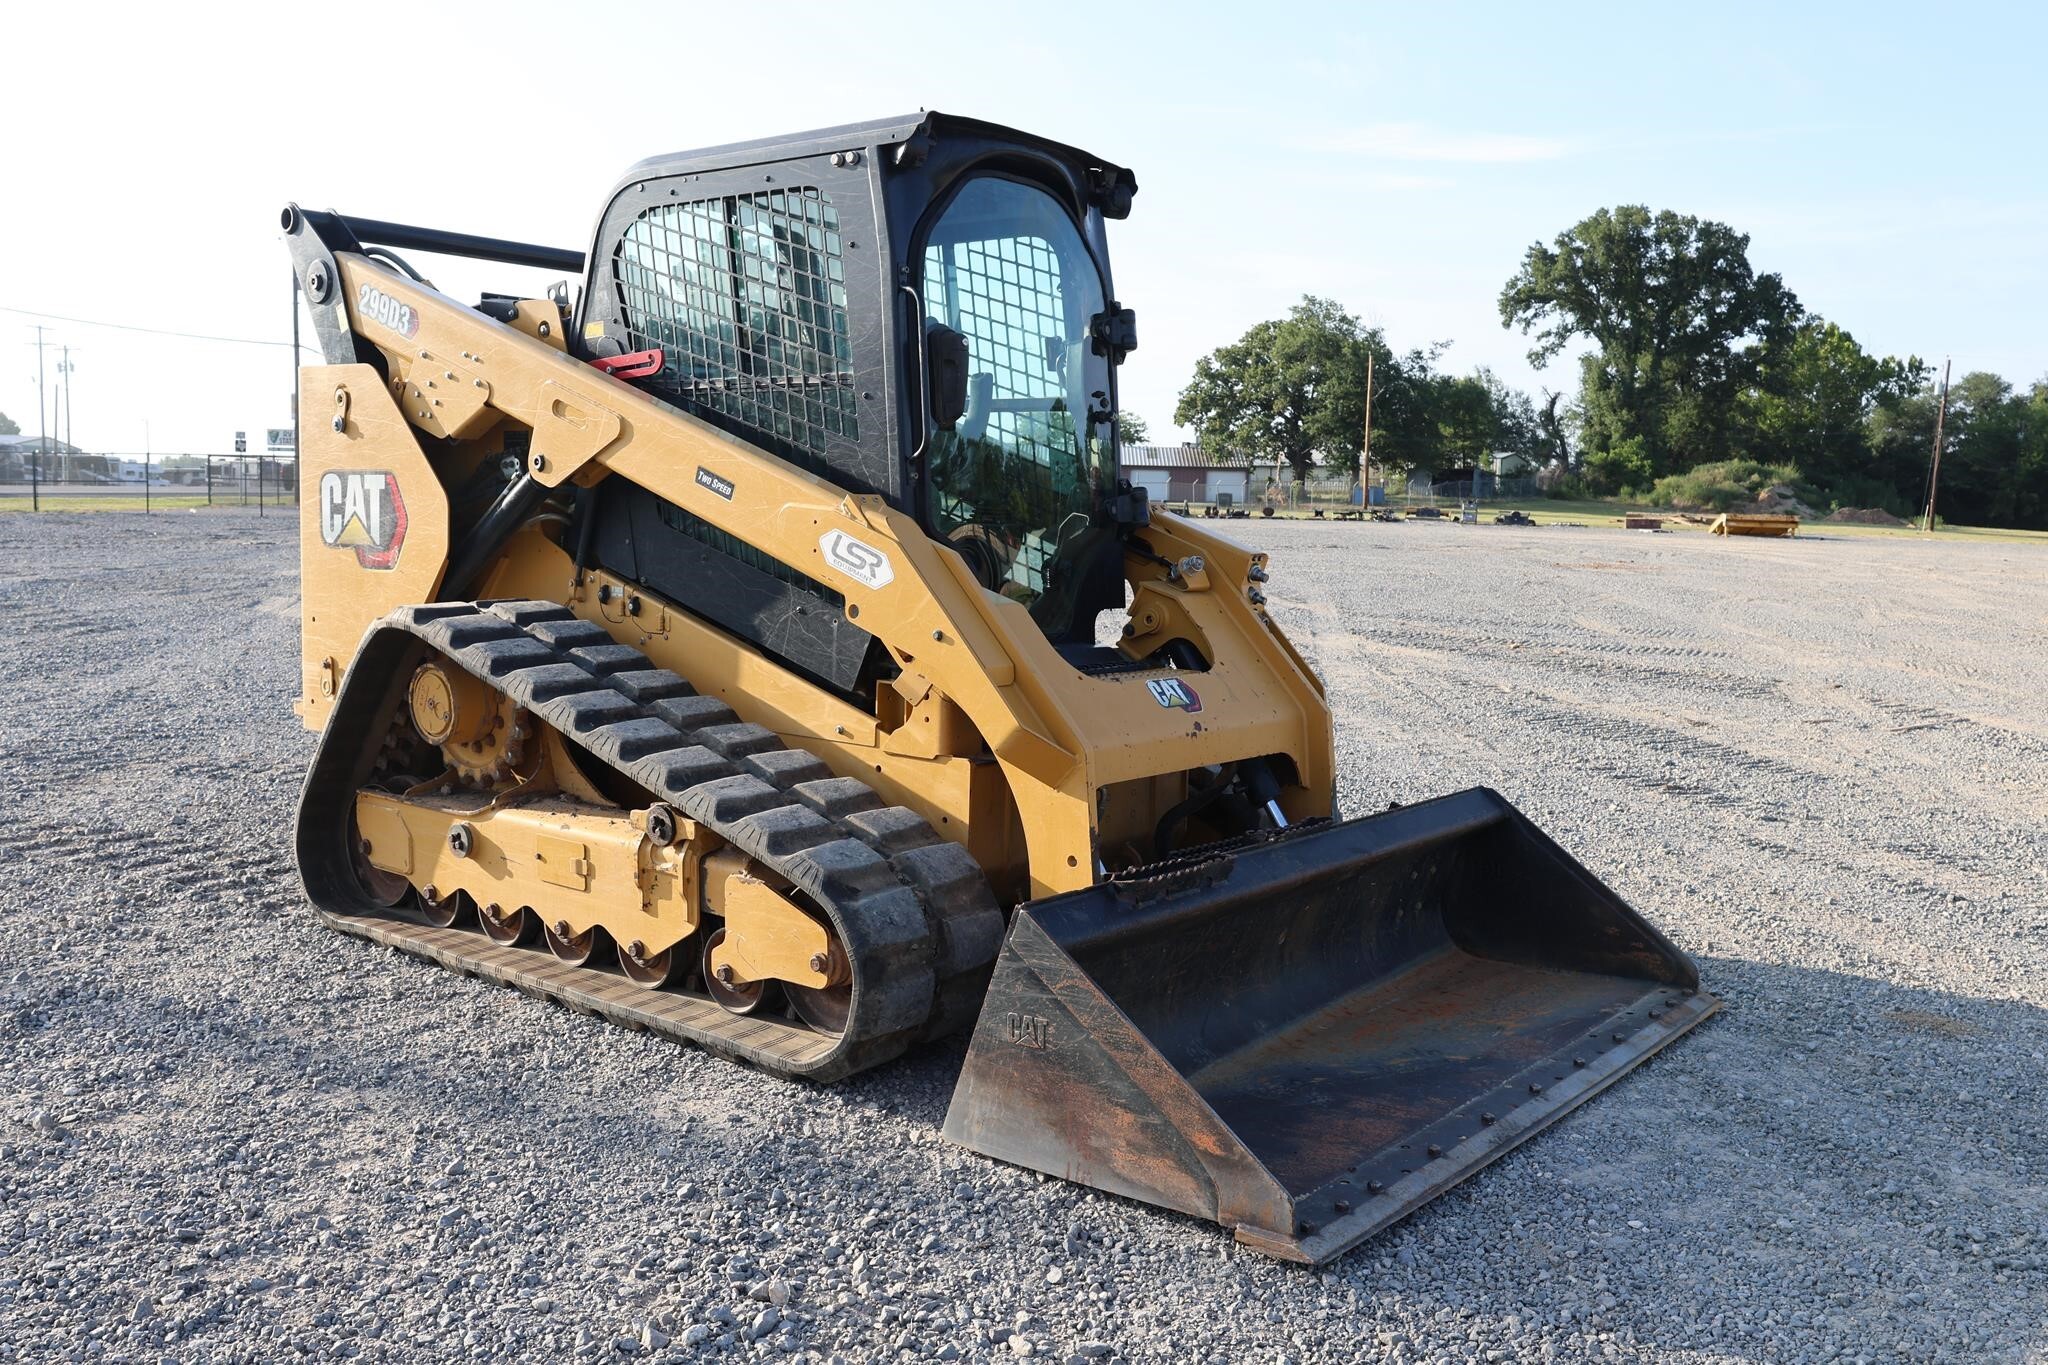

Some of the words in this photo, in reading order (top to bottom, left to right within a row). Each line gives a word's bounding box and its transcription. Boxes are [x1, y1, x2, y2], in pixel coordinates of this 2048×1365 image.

[358, 283, 411, 336] 299D3
[320, 473, 386, 546] CAT
[831, 533, 883, 579] LSR
[832, 558, 873, 584] EQUIPMENT
[1147, 679, 1190, 707] CAT
[1006, 1012, 1049, 1049] CAT
